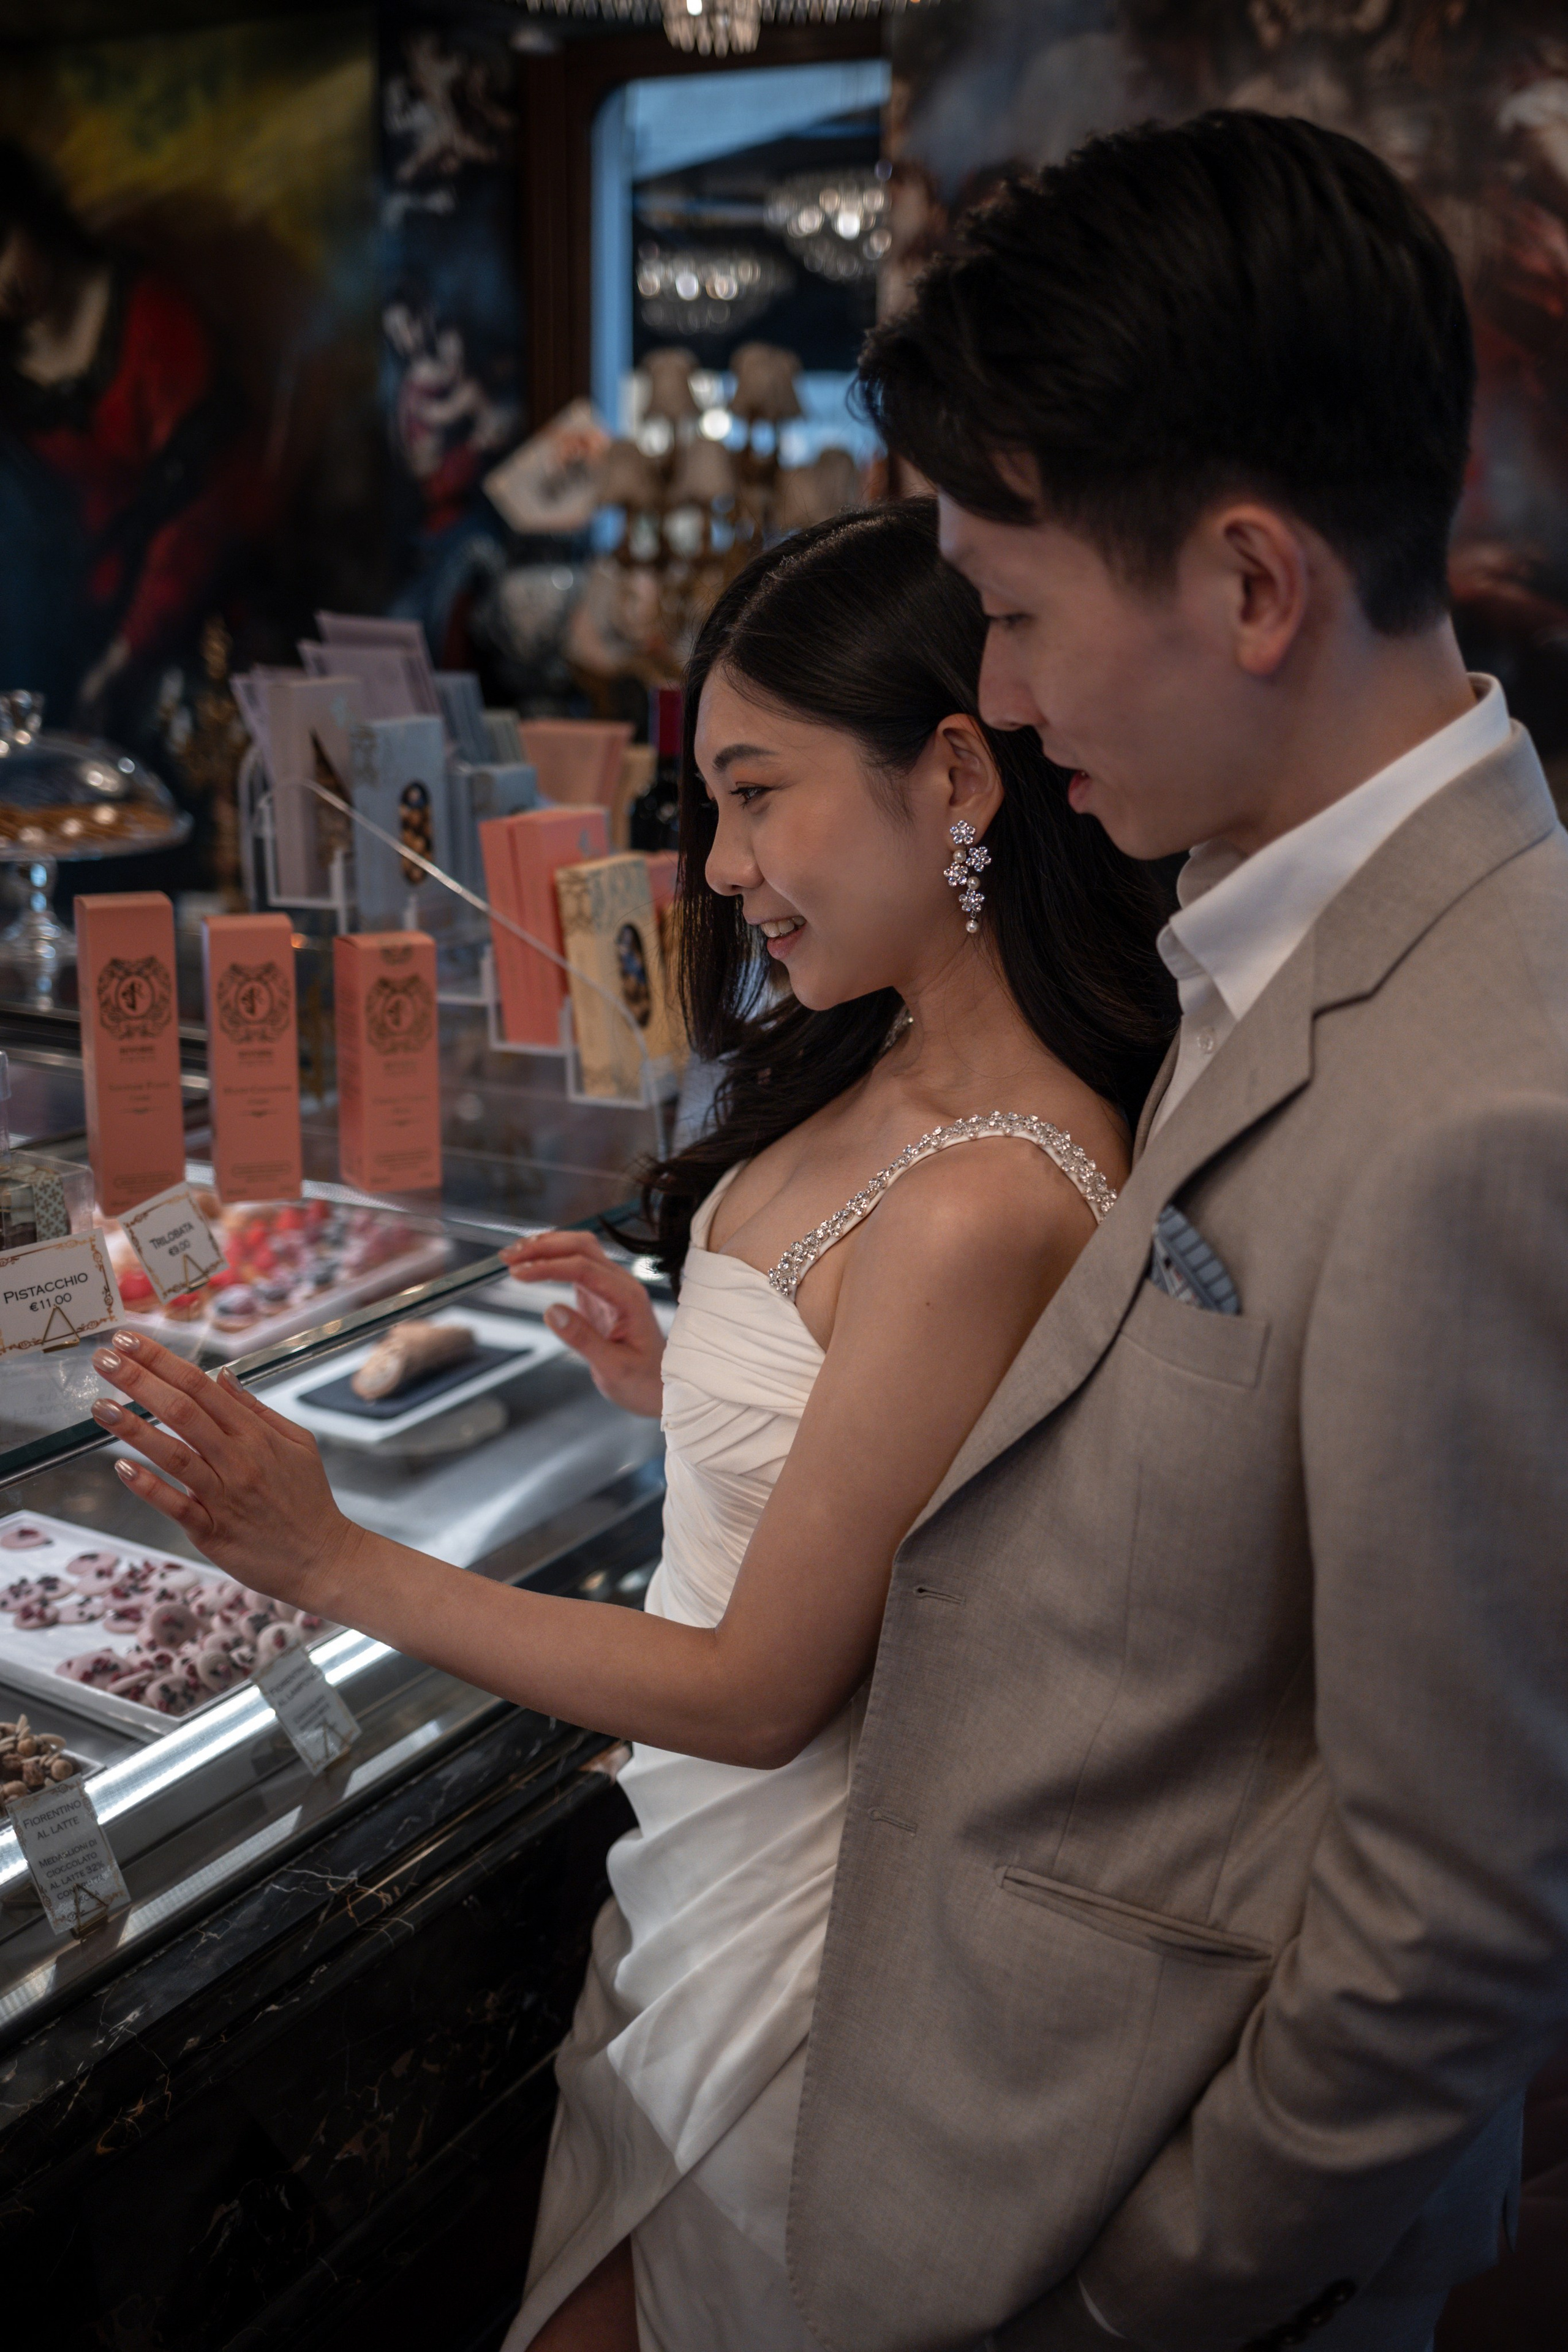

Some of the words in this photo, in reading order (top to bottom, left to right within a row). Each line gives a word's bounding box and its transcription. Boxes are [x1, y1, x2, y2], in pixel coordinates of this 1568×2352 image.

[149, 1222, 194, 1250] TRILOBATA
[4, 1273, 88, 1304] PISTACCHIO
[29, 1293, 72, 1311] €1100
[23, 1800, 81, 1830] FIORENTINO
[37, 1830, 50, 1840] AL
[50, 1816, 80, 1834] LATTE
[39, 1842, 88, 1869] MEDAGLIONI
[89, 1839, 97, 1847] DI
[46, 1852, 97, 1879] CIOCCOLATO
[61, 1870, 85, 1885] LATTE
[86, 1860, 105, 1874] 32%
[76, 1874, 105, 1891] RUTTA
